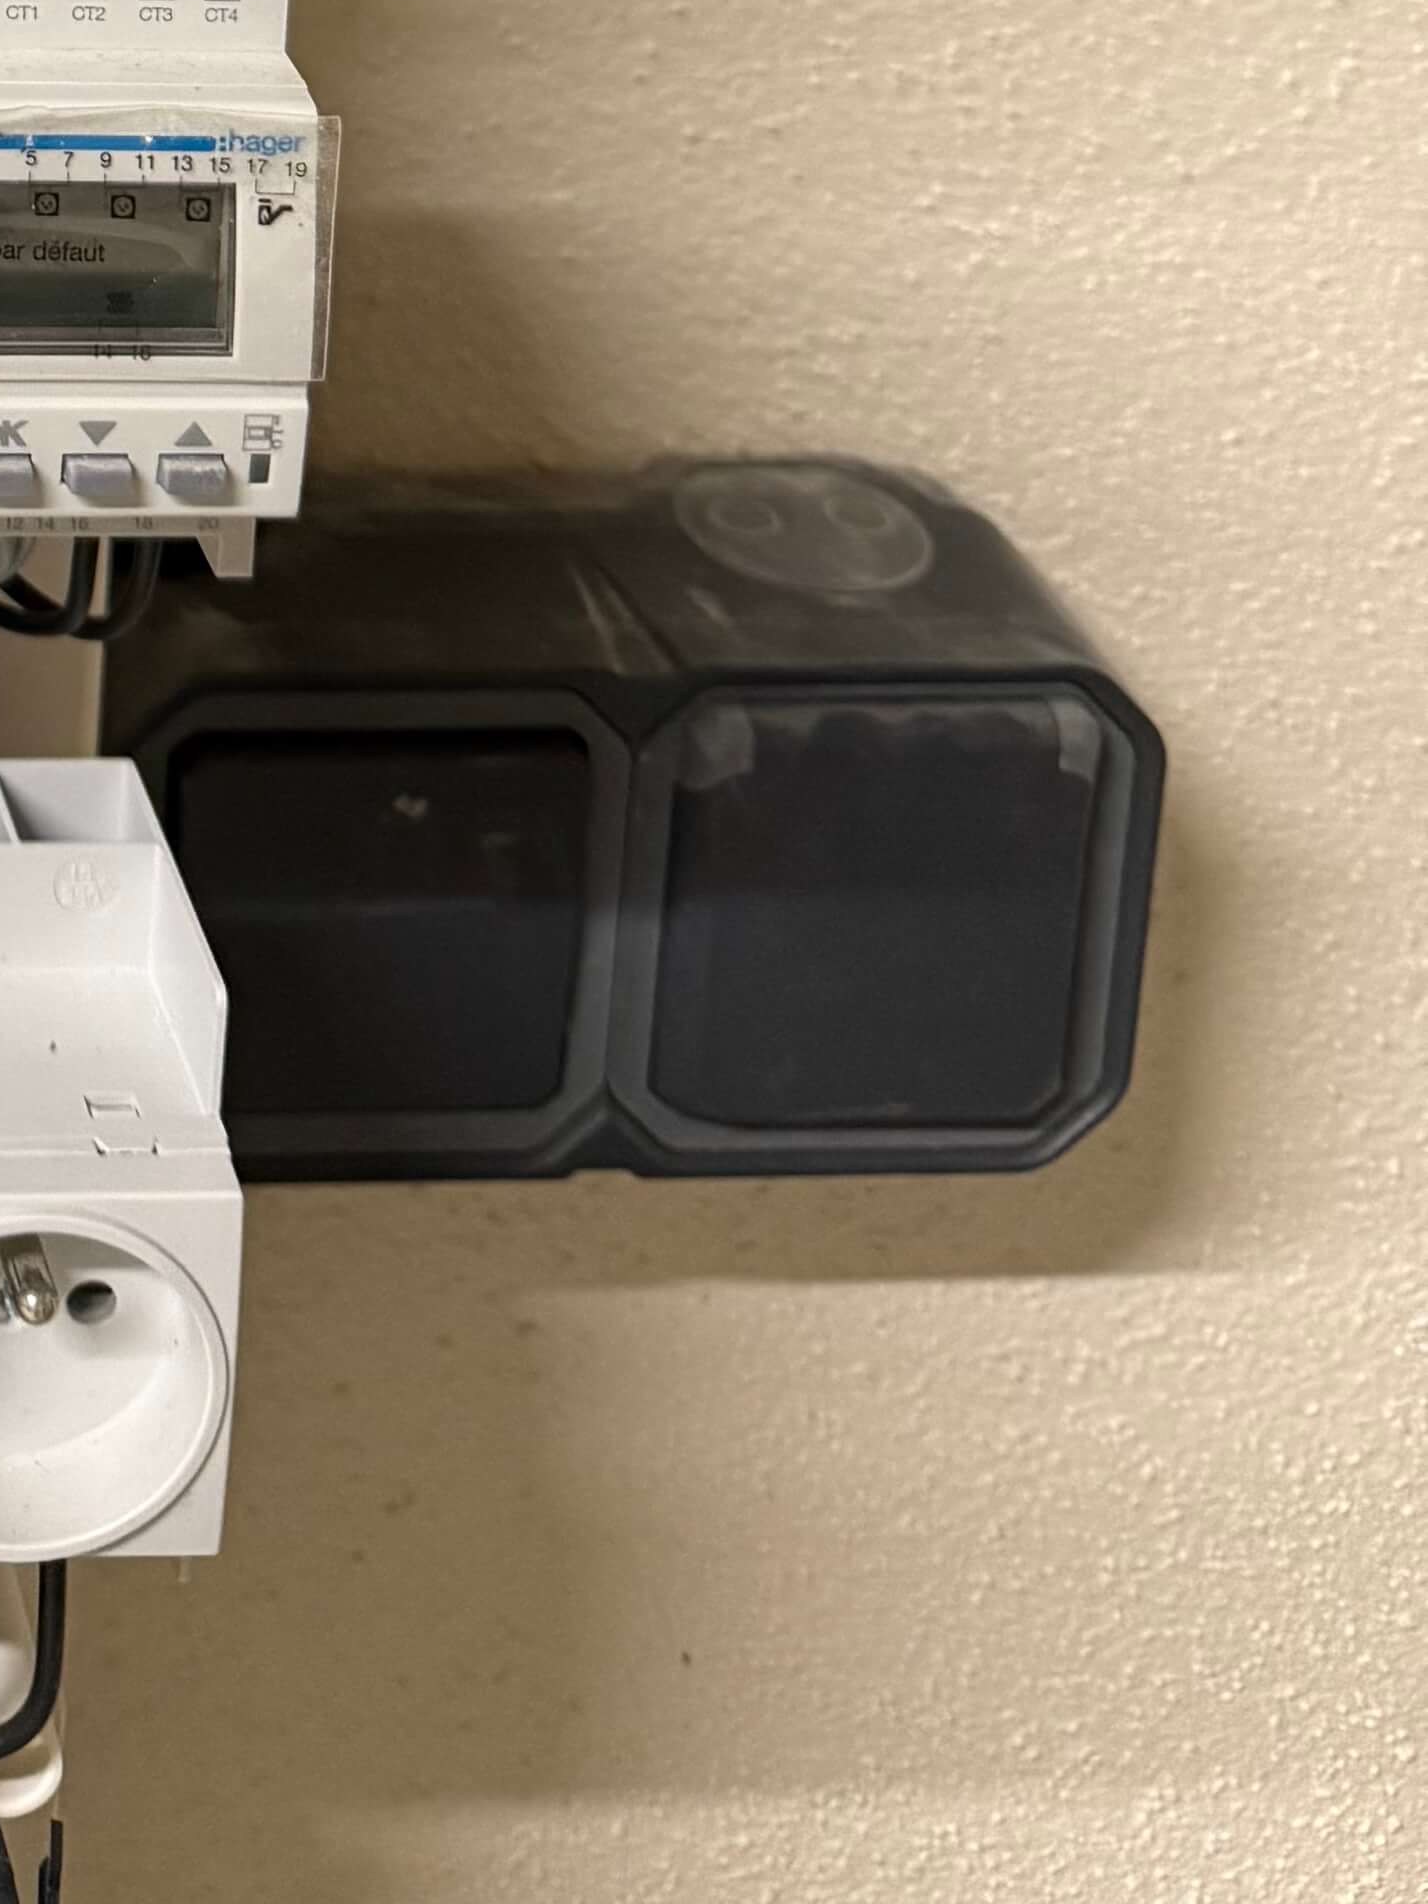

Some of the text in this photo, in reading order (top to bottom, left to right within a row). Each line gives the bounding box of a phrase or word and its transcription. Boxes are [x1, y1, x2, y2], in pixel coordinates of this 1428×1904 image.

[5, 7, 239, 23] CT1 CT2 CT3 CT4
[25, 152, 307, 178] 5 7 9 11 13 15 17 19
[32, 239, 106, 263] défaut
